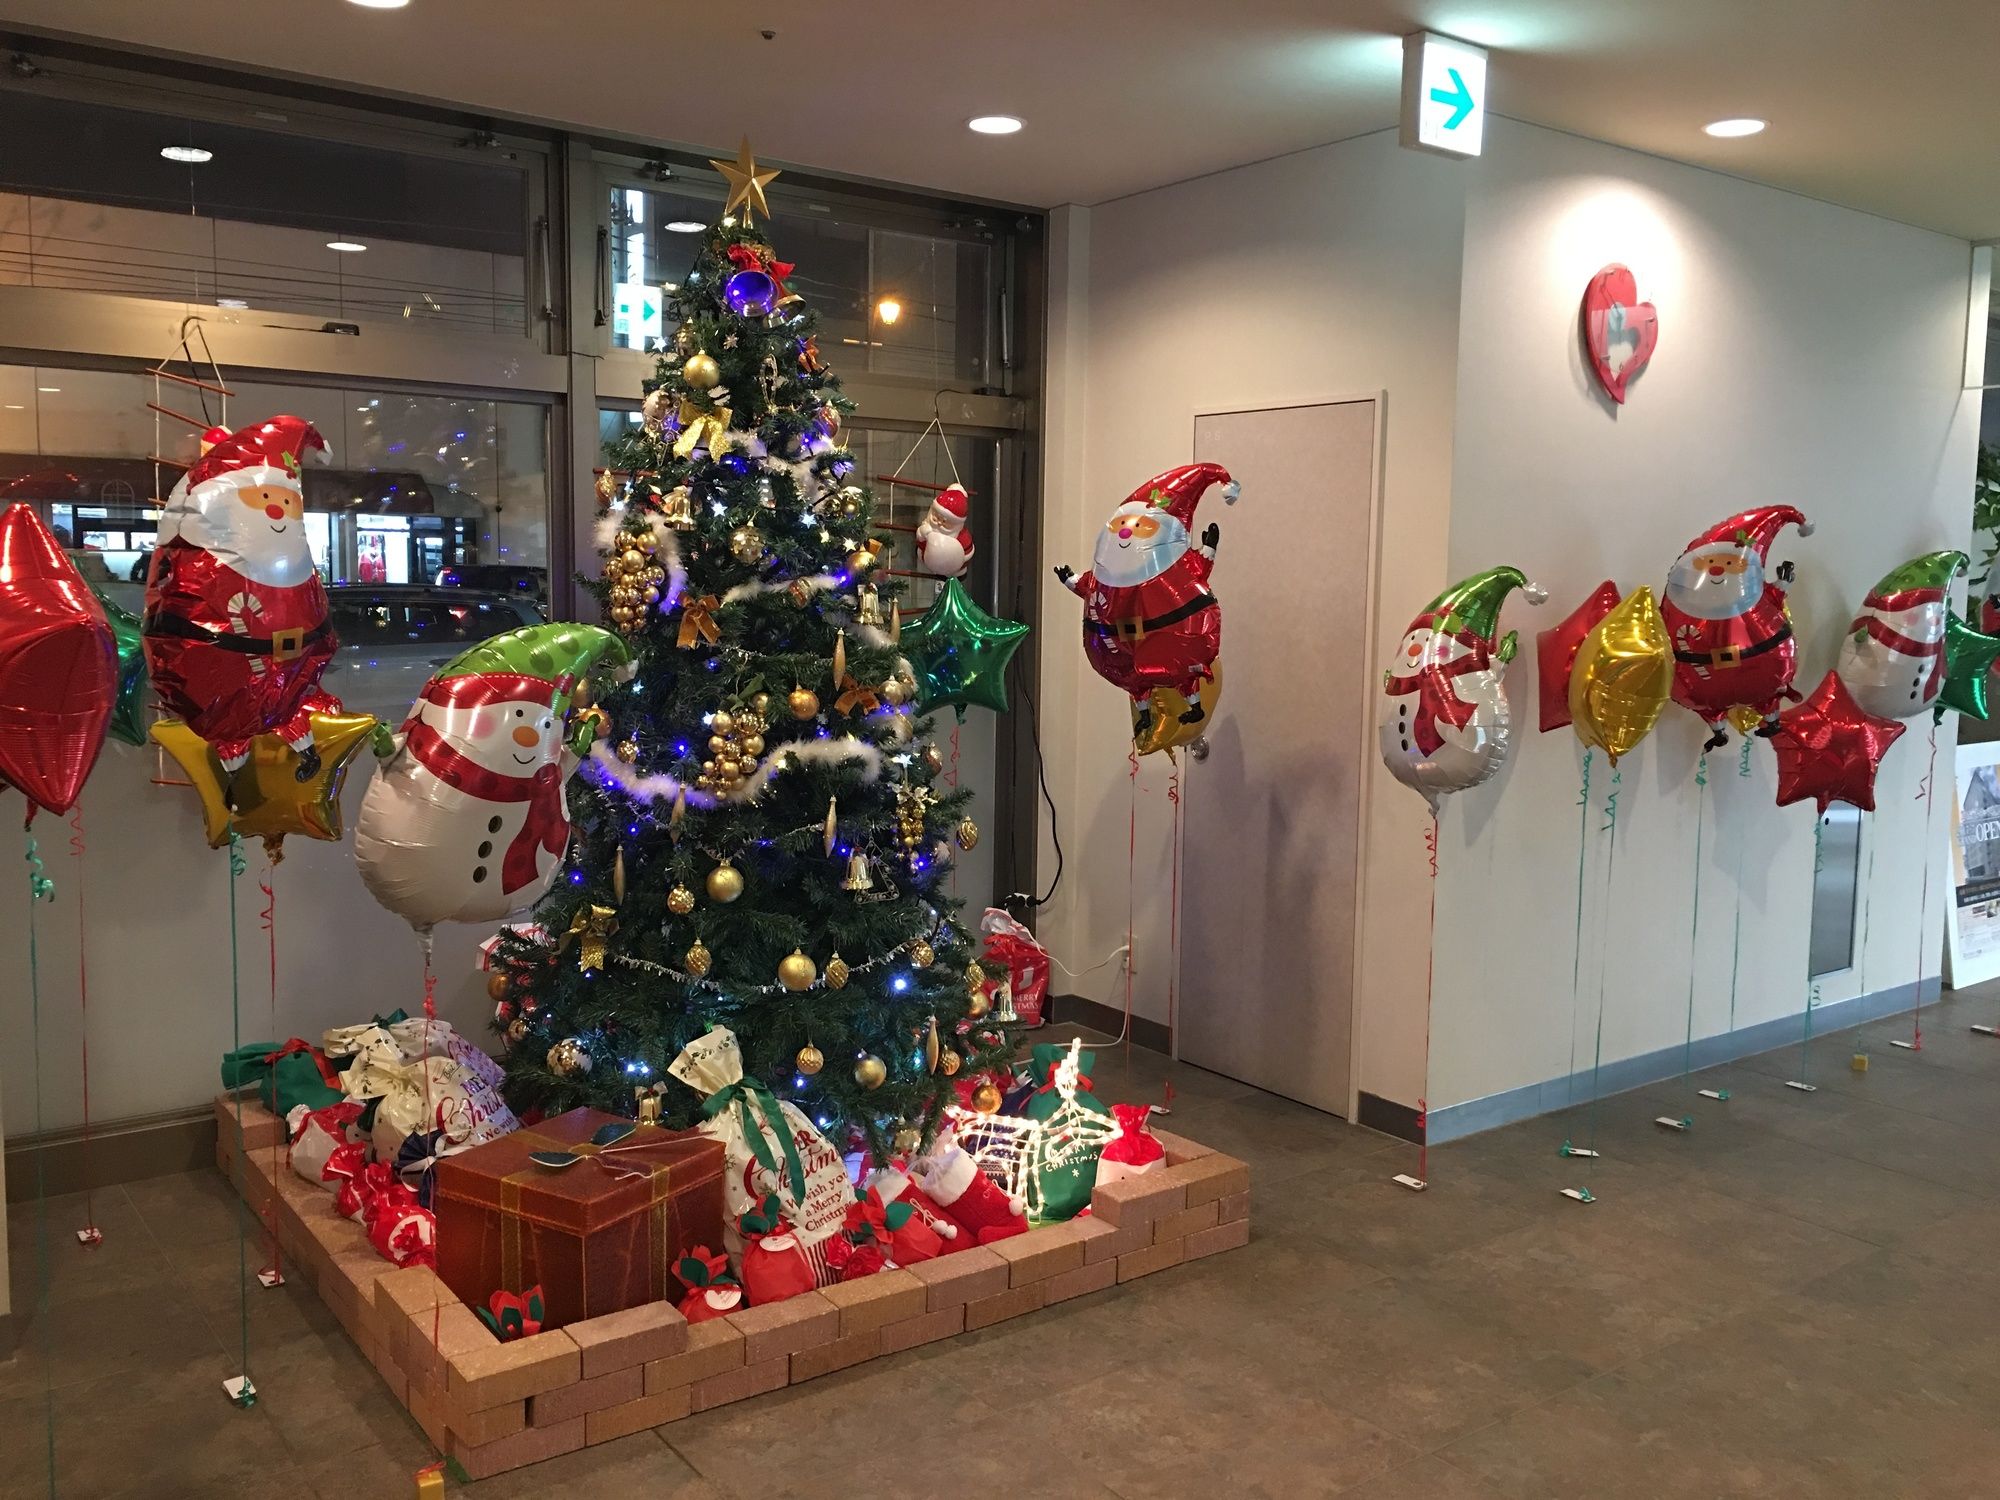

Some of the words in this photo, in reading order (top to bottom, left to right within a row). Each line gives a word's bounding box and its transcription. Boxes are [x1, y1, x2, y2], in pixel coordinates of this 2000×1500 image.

[1975, 820, 2000, 842] OPE
[805, 1183, 827, 1200] wish
[805, 1210, 812, 1218] a
[813, 1190, 842, 1212] Merry
